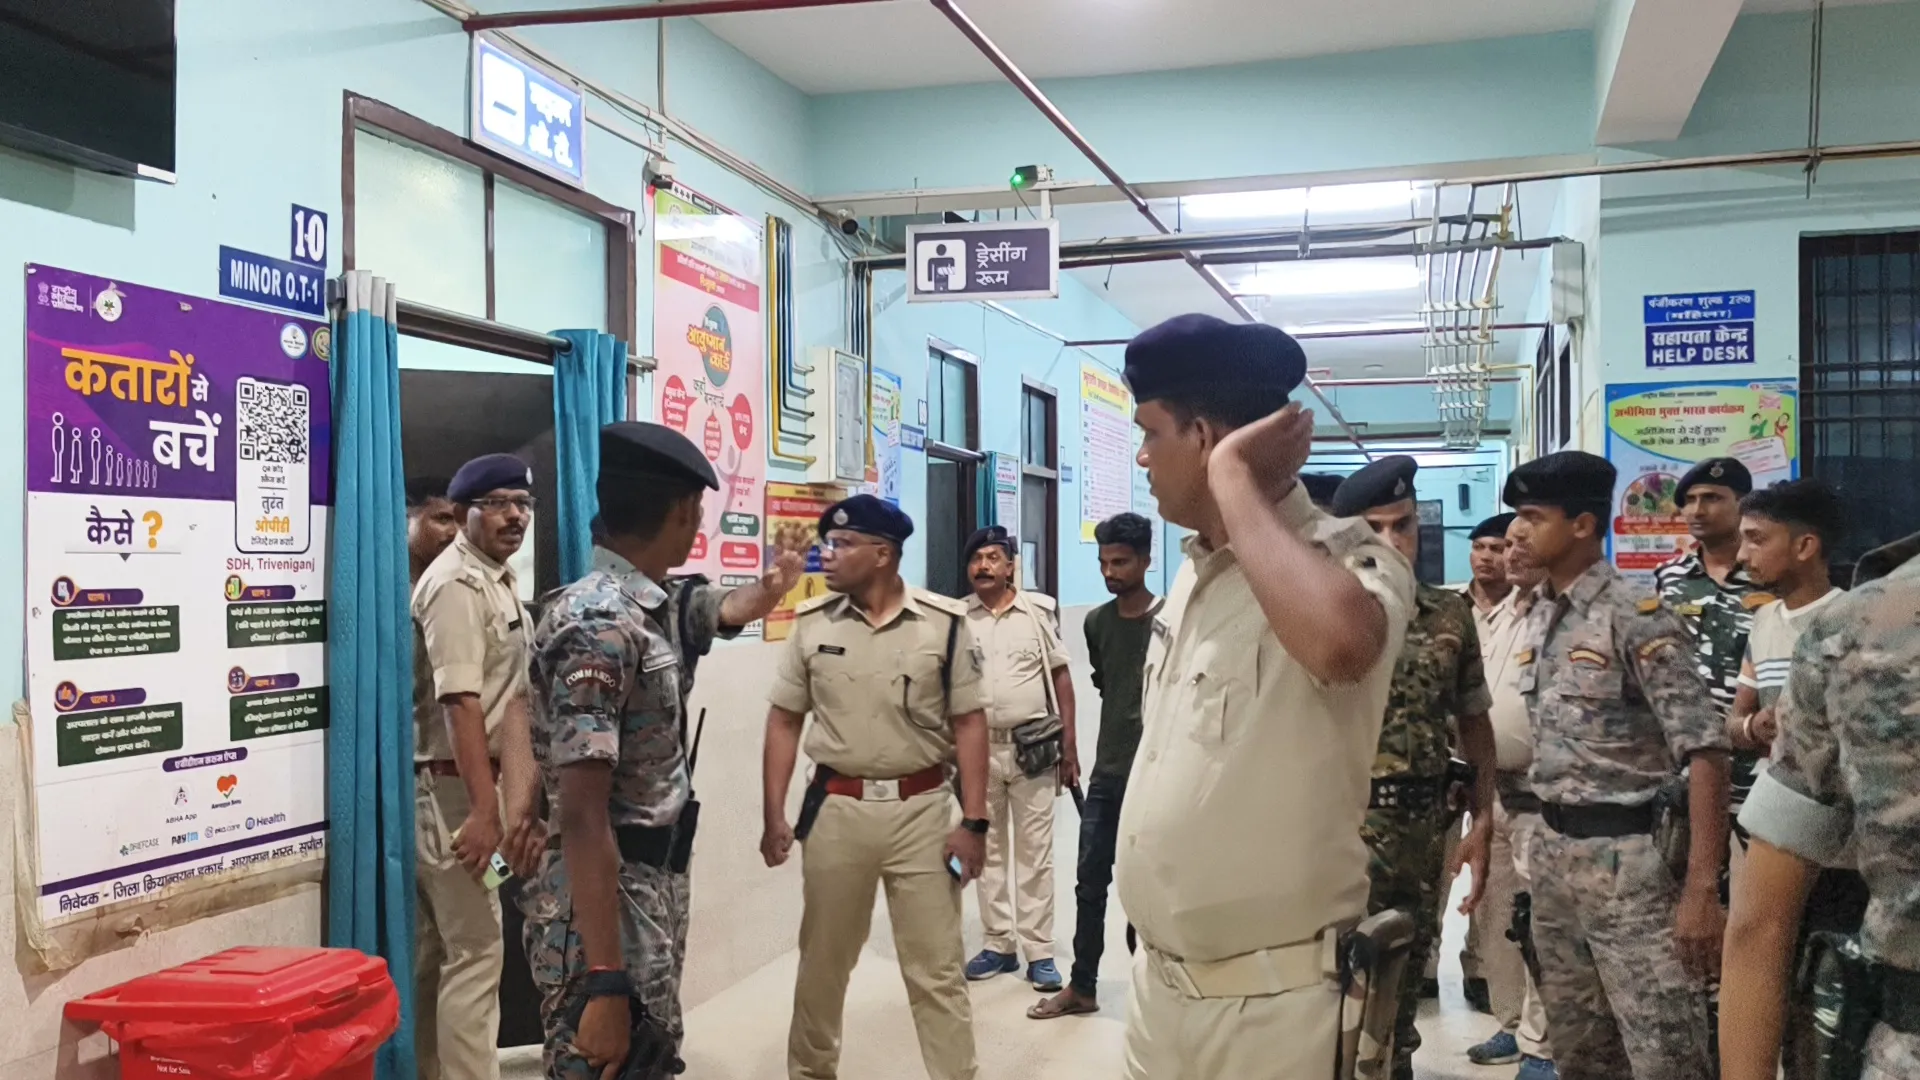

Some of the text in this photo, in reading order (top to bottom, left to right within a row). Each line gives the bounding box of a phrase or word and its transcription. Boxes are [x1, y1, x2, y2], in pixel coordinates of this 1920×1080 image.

[294, 209, 325, 262] 10
[975, 241, 1028, 269] ड्रेसींग
[230, 258, 281, 298] MINOR
[975, 270, 1009, 286] रूम
[1651, 324, 1749, 347] सहायता केन्द्र
[709, 350, 731, 372] कार्ड
[1652, 345, 1749, 365] HELP DESK
[61, 346, 209, 408] कतारों से
[1659, 406, 1681, 420] मुक्त
[1683, 405, 1706, 416] भारत
[149, 409, 222, 472] बचें
[261, 492, 284, 514] तुरंत
[85, 504, 163, 549] कैसे ?
[255, 516, 290, 533] ओपीडी
[226, 557, 315, 573] SDH, Triveniganj
[565, 667, 616, 688] COMMANDO
[256, 812, 286, 827] Health
[59, 891, 100, 914] निवेदक
[113, 880, 140, 900] जिला
[143, 867, 195, 894] क्रियान्वयन
